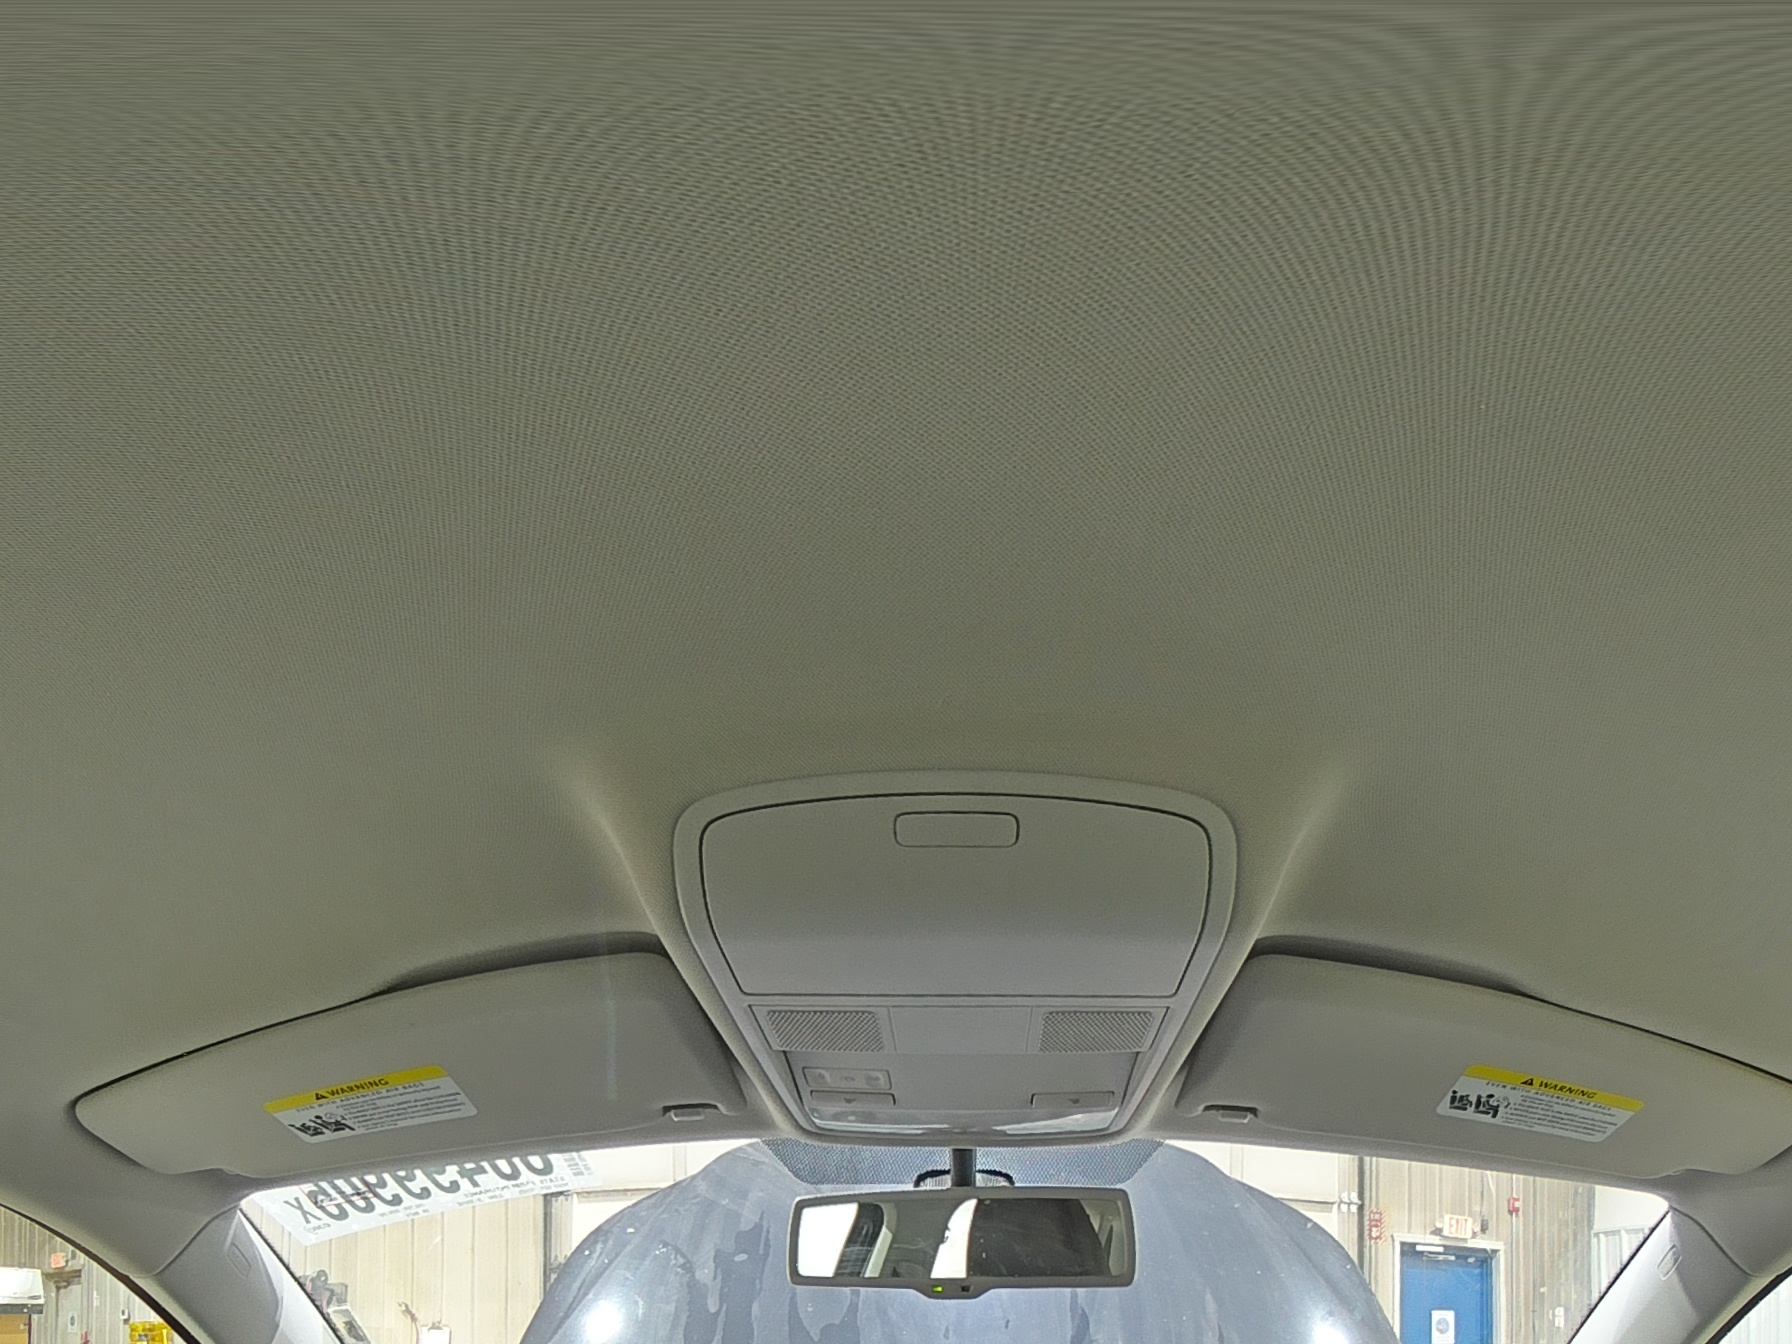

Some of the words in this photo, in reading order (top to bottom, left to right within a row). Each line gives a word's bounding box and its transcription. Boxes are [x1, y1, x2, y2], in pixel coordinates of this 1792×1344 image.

[328, 1078, 389, 1098] WARNING
[1510, 1086, 1532, 1094] WITH
[1534, 1090, 1576, 1103] ADVANCED
[1539, 1080, 1598, 1100] WARNING
[1448, 1216, 1469, 1237] EXIT
